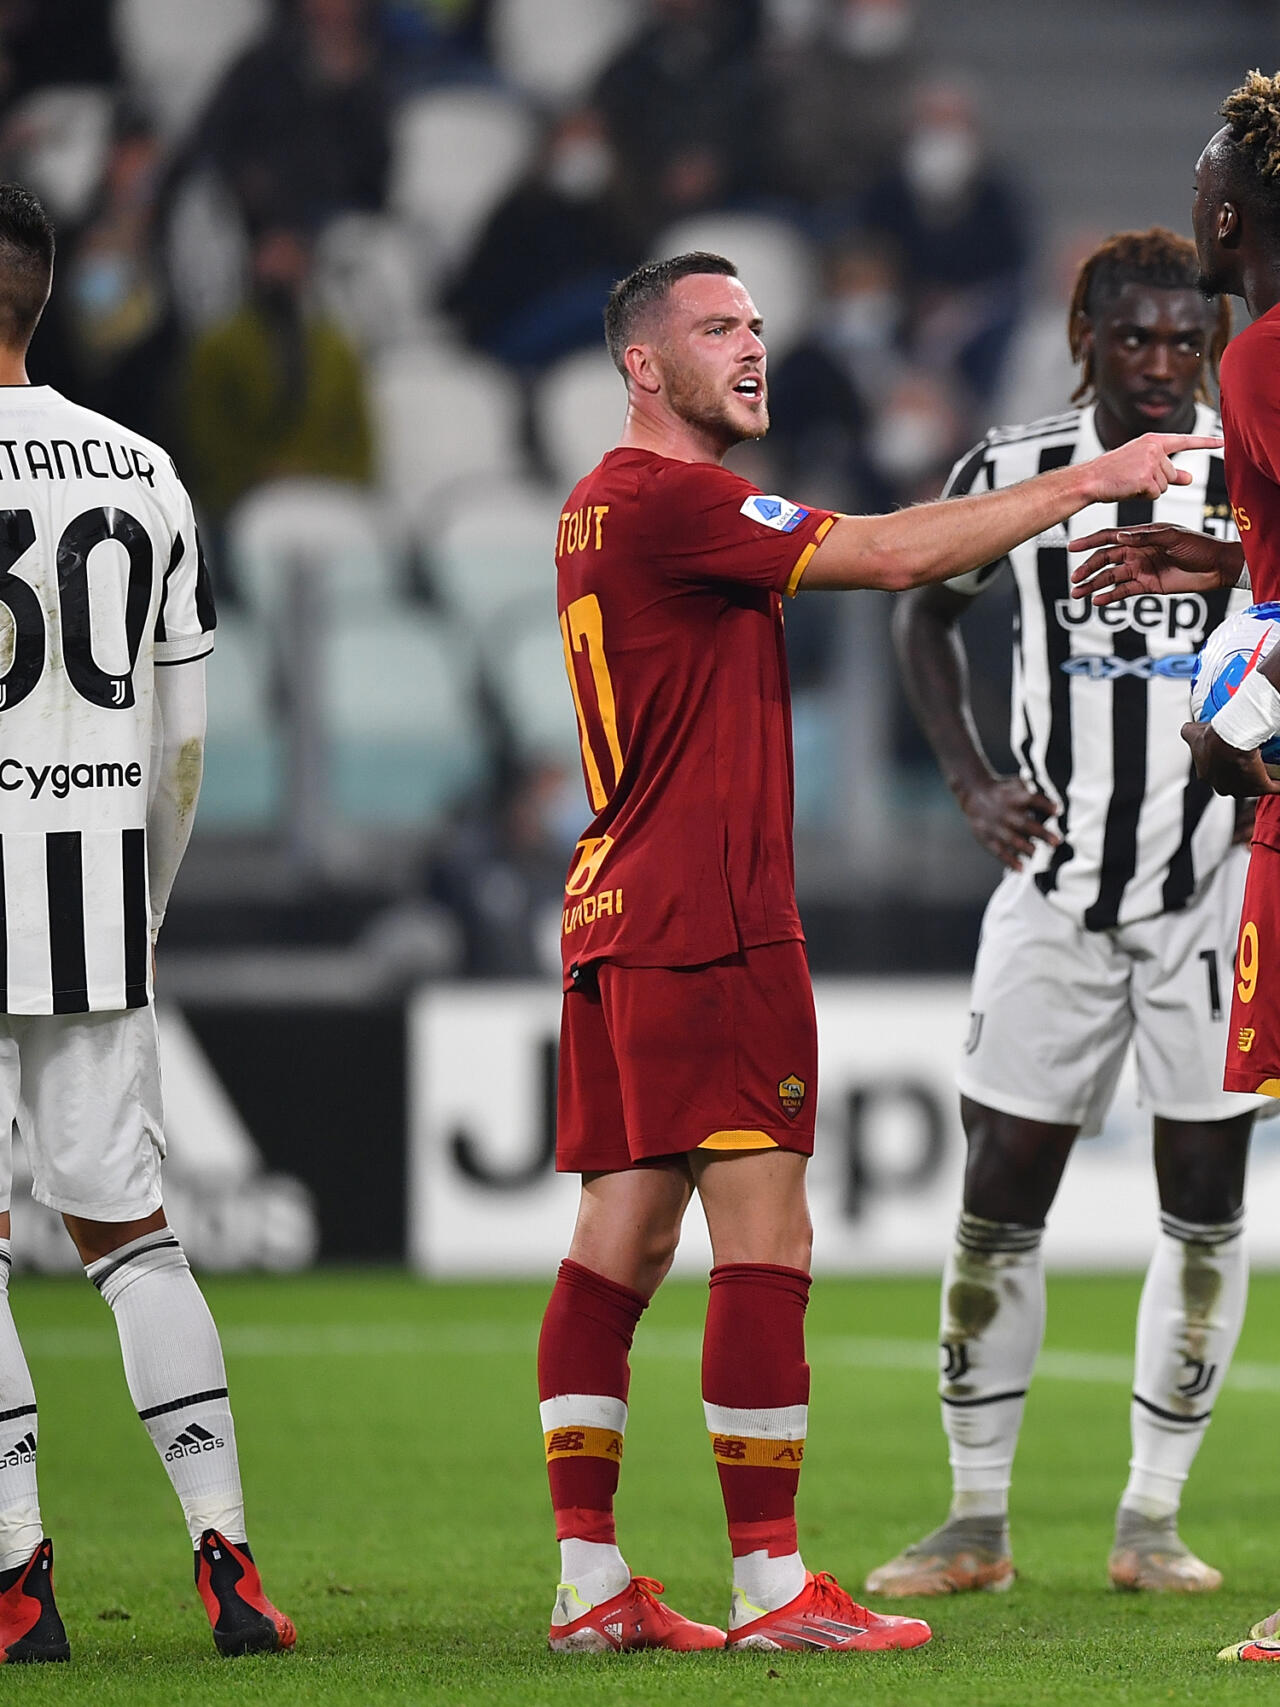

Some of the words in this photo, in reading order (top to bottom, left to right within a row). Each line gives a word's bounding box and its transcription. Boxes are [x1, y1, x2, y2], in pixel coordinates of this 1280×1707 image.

[0, 439, 155, 488] TANCUR
[559, 505, 609, 557] TOUT
[0, 506, 154, 710] 30
[1060, 593, 1202, 639] Jeep
[559, 593, 625, 811] 17
[0, 758, 142, 799] Cygame
[561, 888, 623, 935] UNDAI
[1199, 949, 1237, 1021] 1
[1237, 921, 1259, 1004] 9
[165, 1437, 225, 1462] adidas
